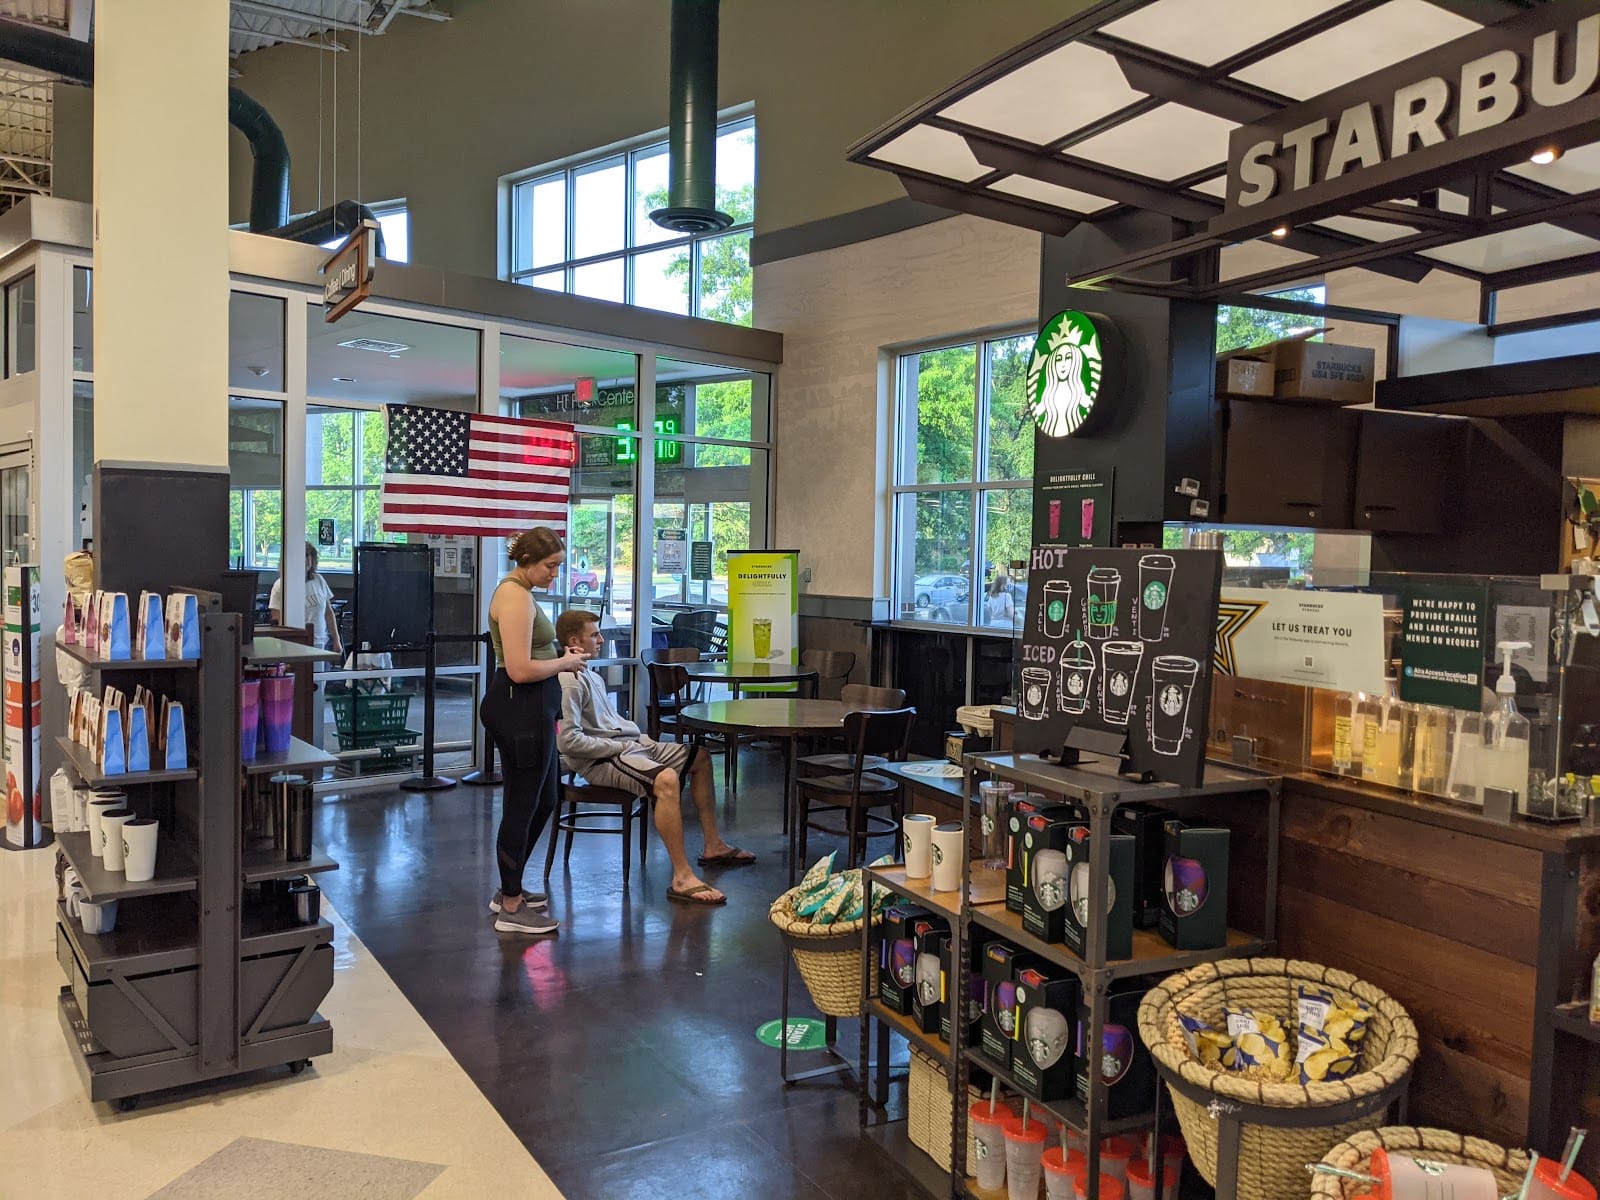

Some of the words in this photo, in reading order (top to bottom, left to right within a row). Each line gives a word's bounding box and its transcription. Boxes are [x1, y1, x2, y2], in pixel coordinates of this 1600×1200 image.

[1237, 14, 1600, 207] STARBU
[326, 278, 339, 300] Coffee
[342, 263, 356, 287] Dining
[1316, 360, 1362, 373] STARBUCKS
[556, 393, 568, 410] HT
[1031, 549, 1068, 570] HOT
[1412, 600, 1434, 608] WE'RE
[1438, 600, 1463, 610] HAPPY
[1466, 602, 1476, 610] TO
[1410, 611, 1442, 620] PROVIDE
[1445, 614, 1477, 623] BRAILLE
[1272, 622, 1286, 631] LET
[1288, 624, 1300, 632] US
[1302, 625, 1330, 635] TREAT
[1333, 628, 1352, 637] YOU
[1409, 622, 1423, 631] AND
[1426, 624, 1477, 636] LARGE-PRINT
[1406, 634, 1430, 643] MENUS
[1433, 636, 1442, 644] ON
[1446, 638, 1480, 648] REQUEST
[1023, 644, 1056, 663] ICED
[787, 1023, 809, 1044] STAND
